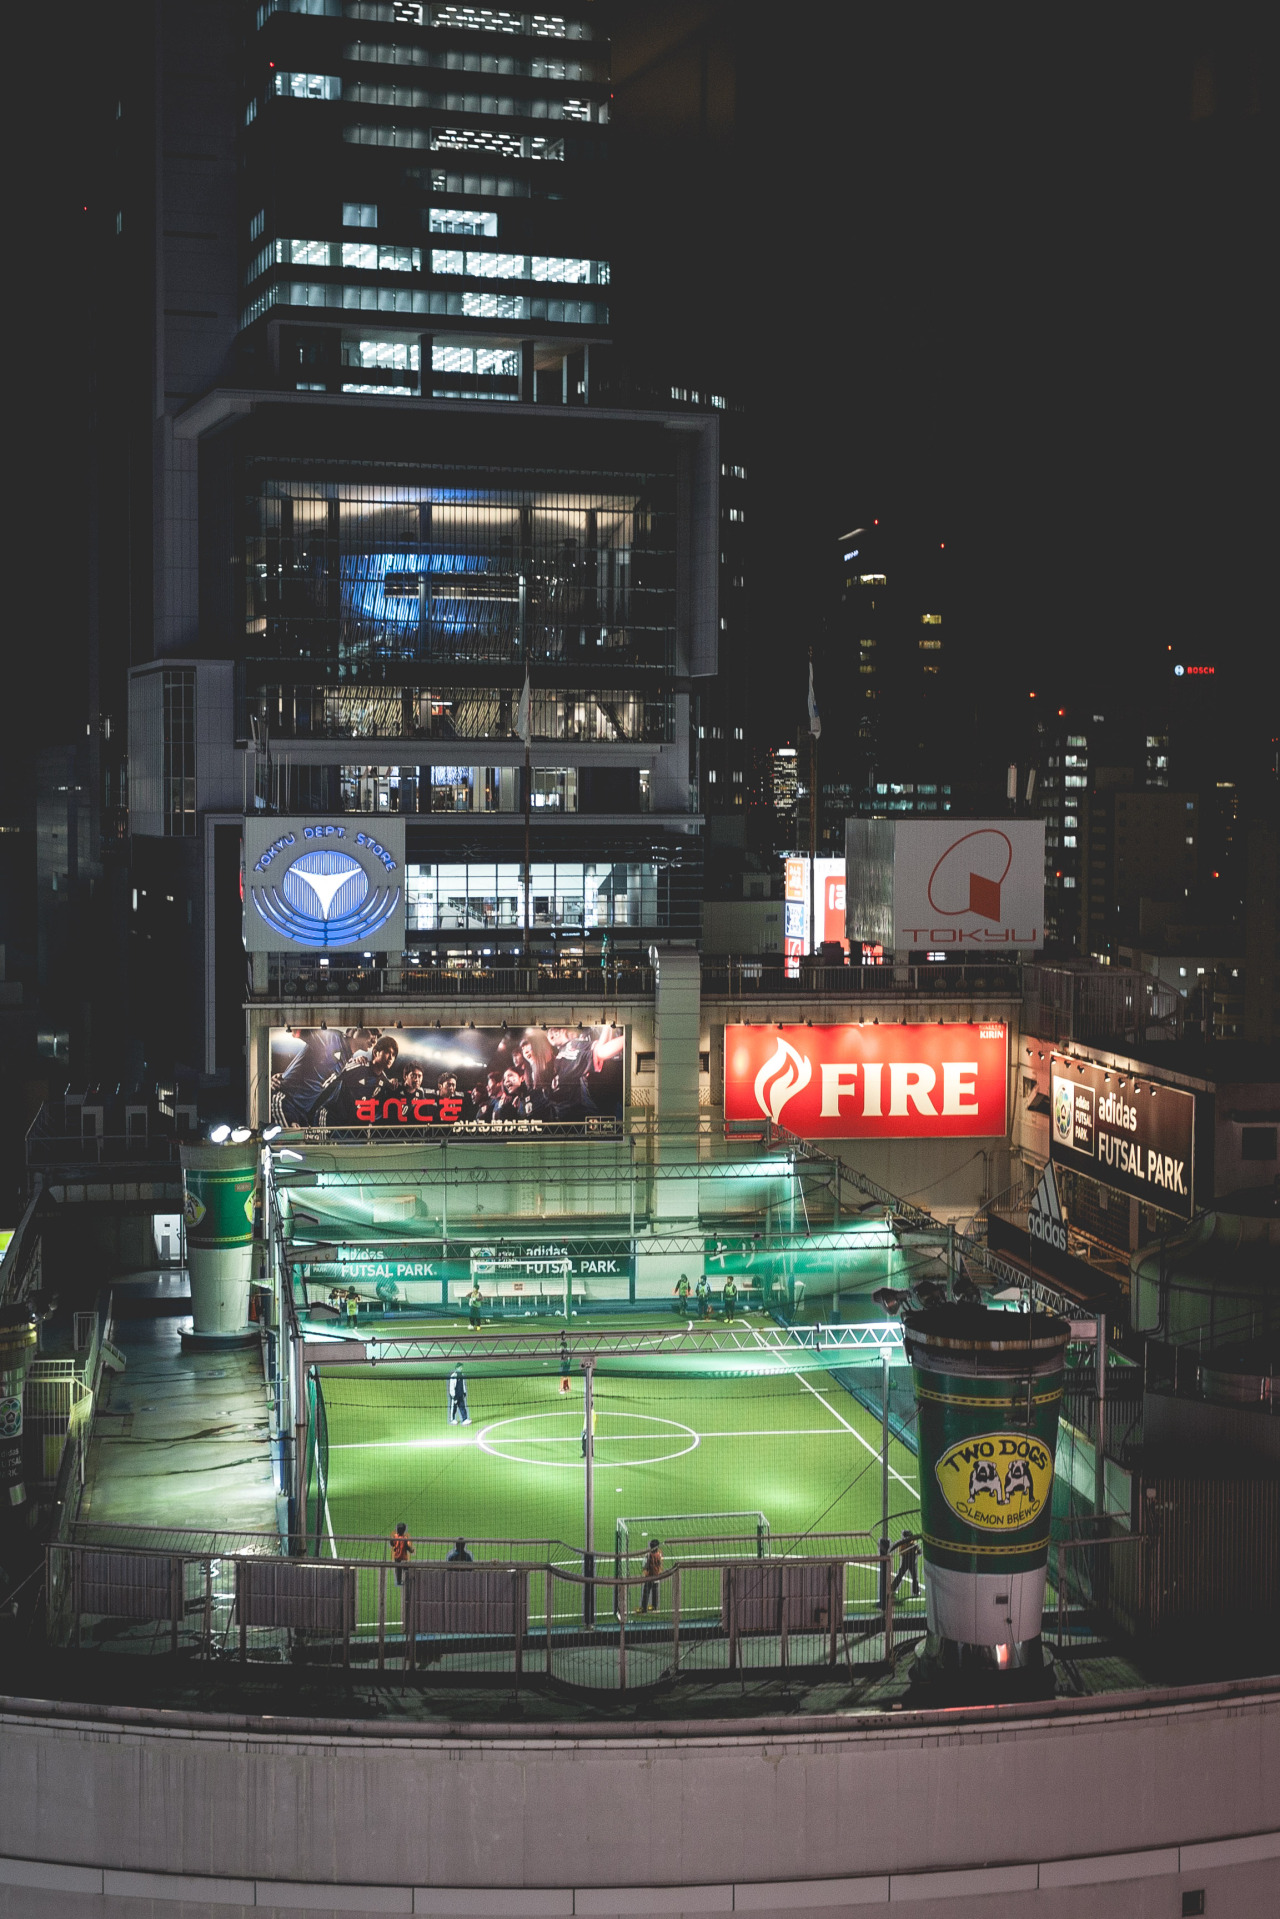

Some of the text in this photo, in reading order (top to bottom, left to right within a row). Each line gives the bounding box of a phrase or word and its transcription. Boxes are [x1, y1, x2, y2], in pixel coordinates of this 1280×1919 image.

[1187, 666, 1215, 675] BOSCH
[253, 825, 397, 874] TOKYU DEPT. STORE
[902, 928, 1037, 943] TOKYU
[980, 1030, 1004, 1039] KIRIN
[819, 1061, 979, 1117] FIRE
[354, 1097, 463, 1122] すべてを
[1075, 1095, 1090, 1111] adidas
[1098, 1092, 1137, 1132] adidas
[1075, 1110, 1092, 1127] FUTSAL
[1098, 1131, 1145, 1179] FUTSAL
[1027, 1208, 1068, 1251] adidas
[526, 1246, 568, 1256] adidas
[341, 1264, 393, 1277] FUTSAL
[943, 1440, 1049, 1472] TWO DOGS
[968, 1506, 1033, 1525] LEMON BREW
